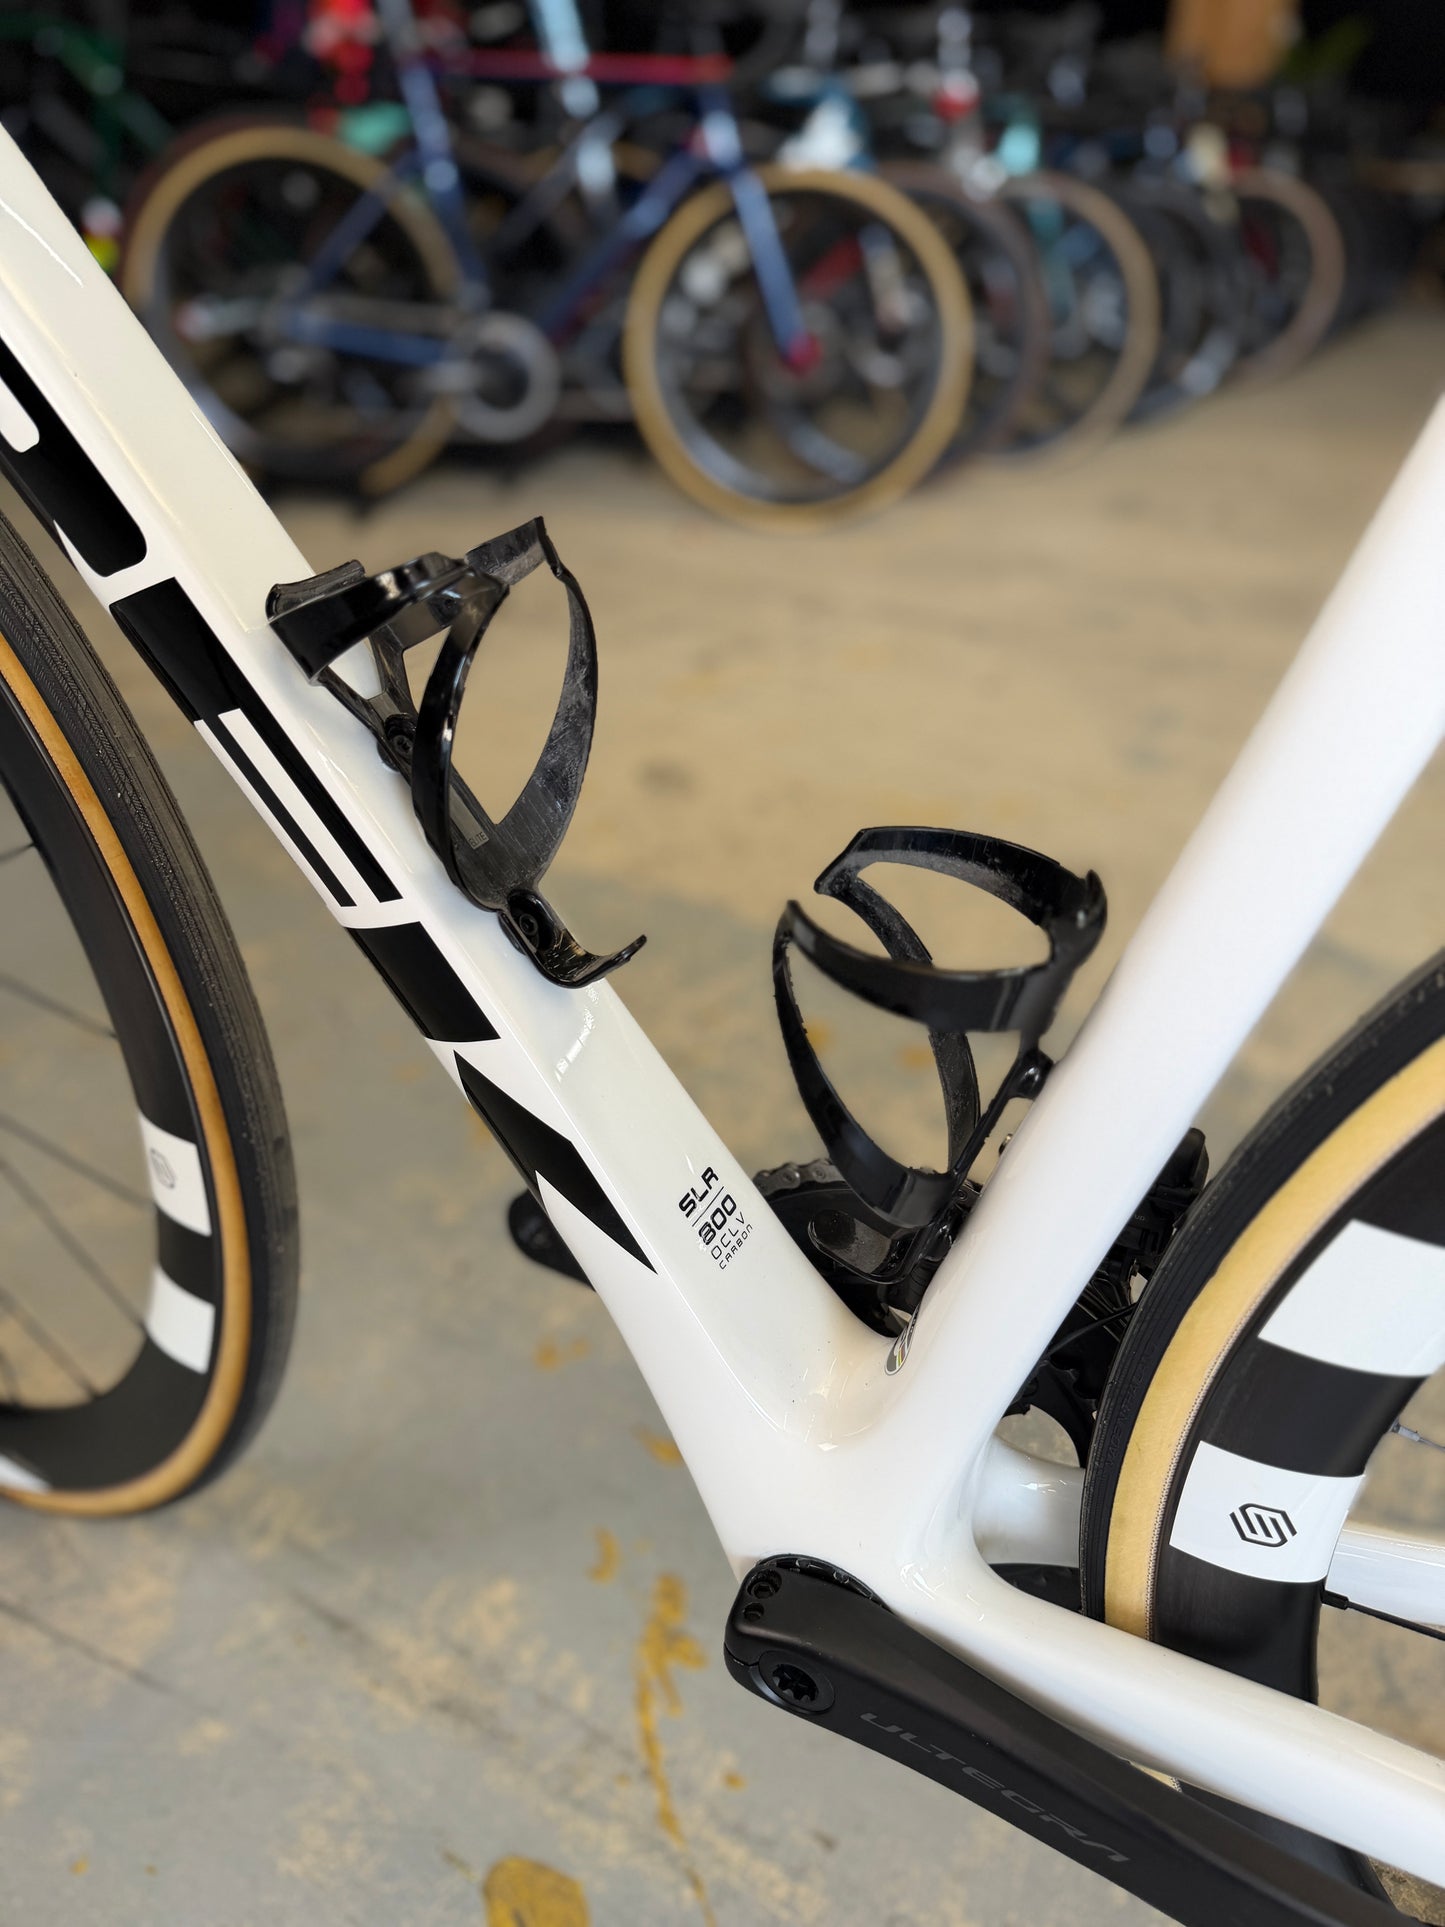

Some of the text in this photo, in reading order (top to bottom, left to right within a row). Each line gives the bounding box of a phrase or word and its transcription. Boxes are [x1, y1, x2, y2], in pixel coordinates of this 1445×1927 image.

[679, 1166, 719, 1218] SLR
[698, 1193, 737, 1246] 800
[710, 1211, 745, 1260] OCLV
[719, 1223, 753, 1270] CARBON
[860, 1712, 1131, 1863] ULTEGRA
